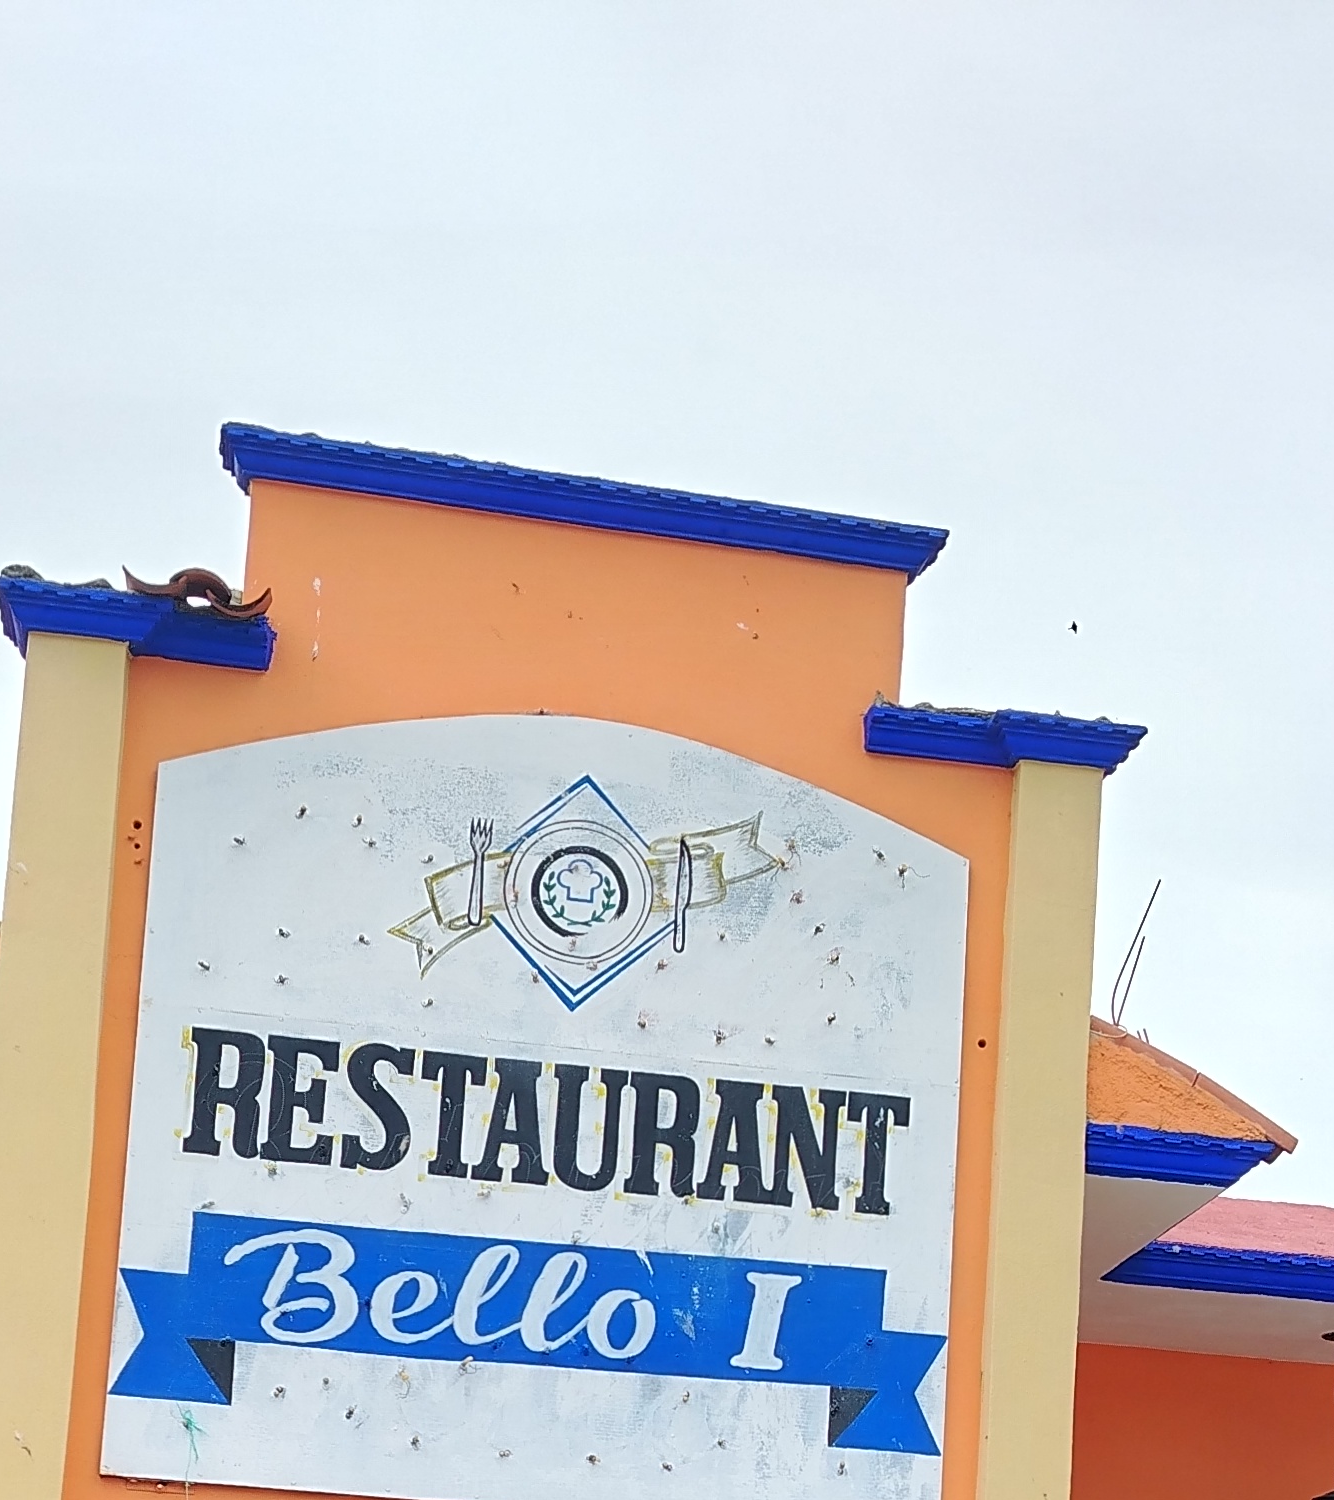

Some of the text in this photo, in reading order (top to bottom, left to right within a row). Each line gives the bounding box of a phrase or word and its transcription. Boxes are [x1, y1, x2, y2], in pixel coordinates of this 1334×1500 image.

[182, 1027, 911, 1215] RESTAURANT
[224, 1229, 802, 1370] Bello I
